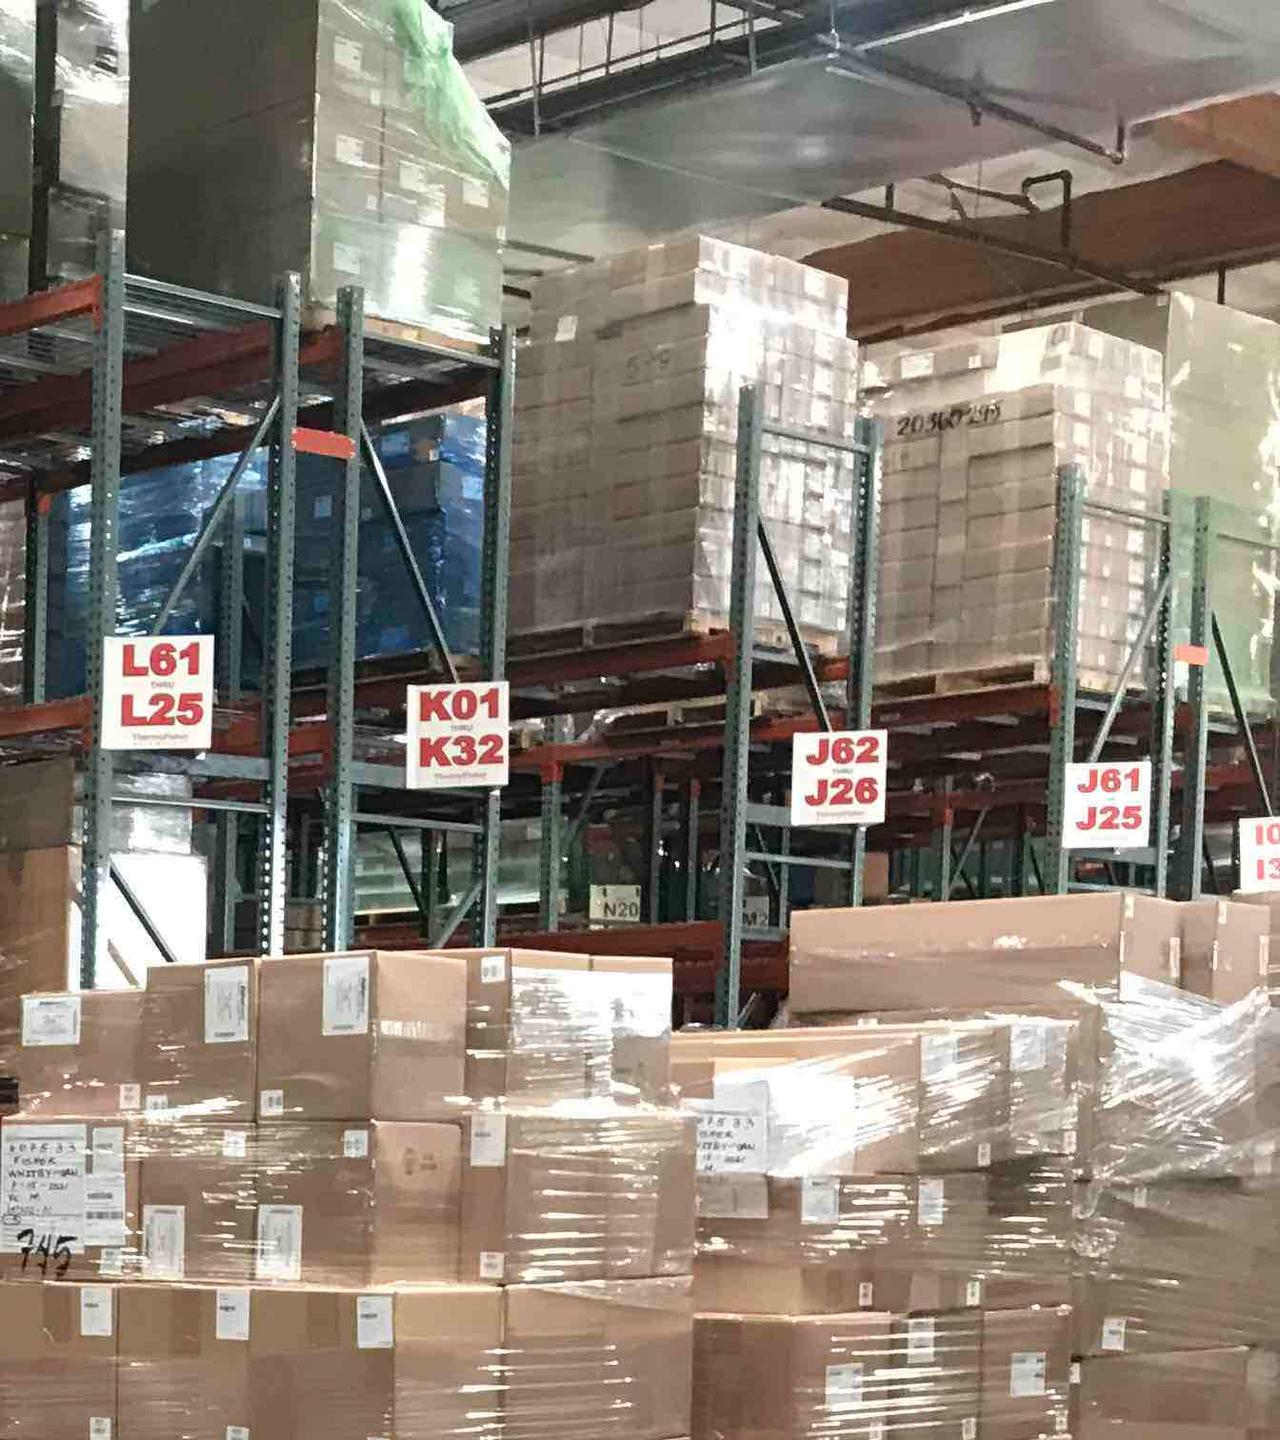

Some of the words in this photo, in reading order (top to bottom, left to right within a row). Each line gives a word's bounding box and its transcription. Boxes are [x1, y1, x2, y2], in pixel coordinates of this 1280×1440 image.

[122, 642, 200, 676] L61
[121, 692, 204, 727] L25
[420, 688, 500, 722] K01
[420, 734, 504, 768] K32
[805, 736, 880, 766] J62
[804, 777, 879, 807] J26
[1076, 767, 1140, 794] J61
[1075, 805, 1143, 831] J25
